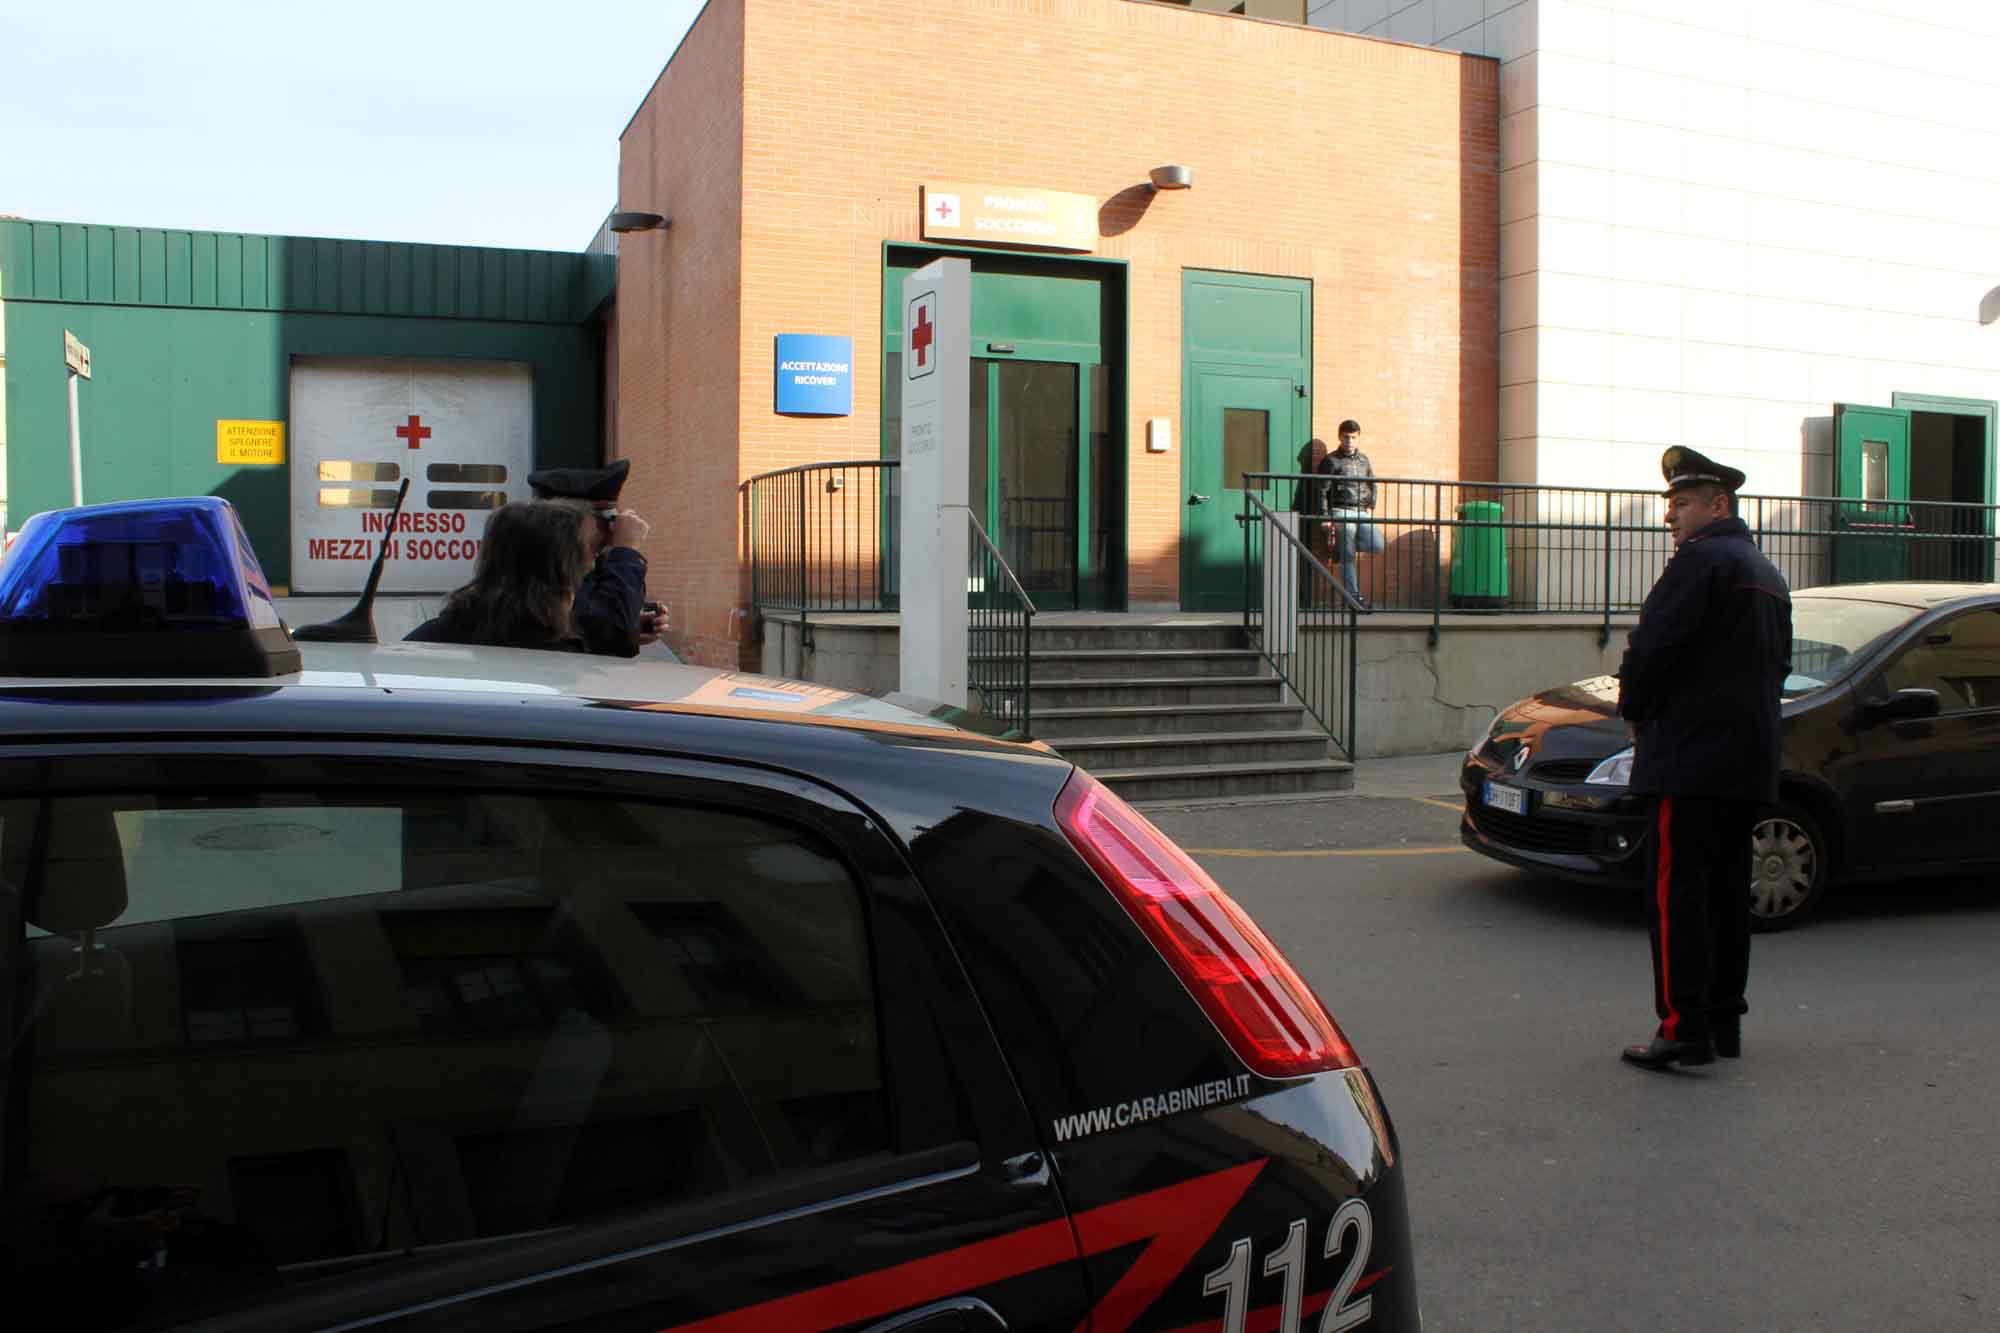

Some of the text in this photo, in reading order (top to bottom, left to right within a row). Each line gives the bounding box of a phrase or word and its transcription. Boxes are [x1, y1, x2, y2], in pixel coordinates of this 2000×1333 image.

[781, 361, 849, 374] ACCETTAZIONE
[794, 375, 837, 386] RICOVERI
[226, 426, 277, 437] ATTENZIONE
[229, 438, 273, 447] SPEGNERE
[230, 447, 273, 457] IL MOTORE
[362, 511, 465, 533] INGRESSO
[309, 538, 482, 560] MEZZI DI SOCCO
[1053, 1073, 1250, 1142] WWW.CARABINIERI.IT
[1202, 1197, 1373, 1333] 112
